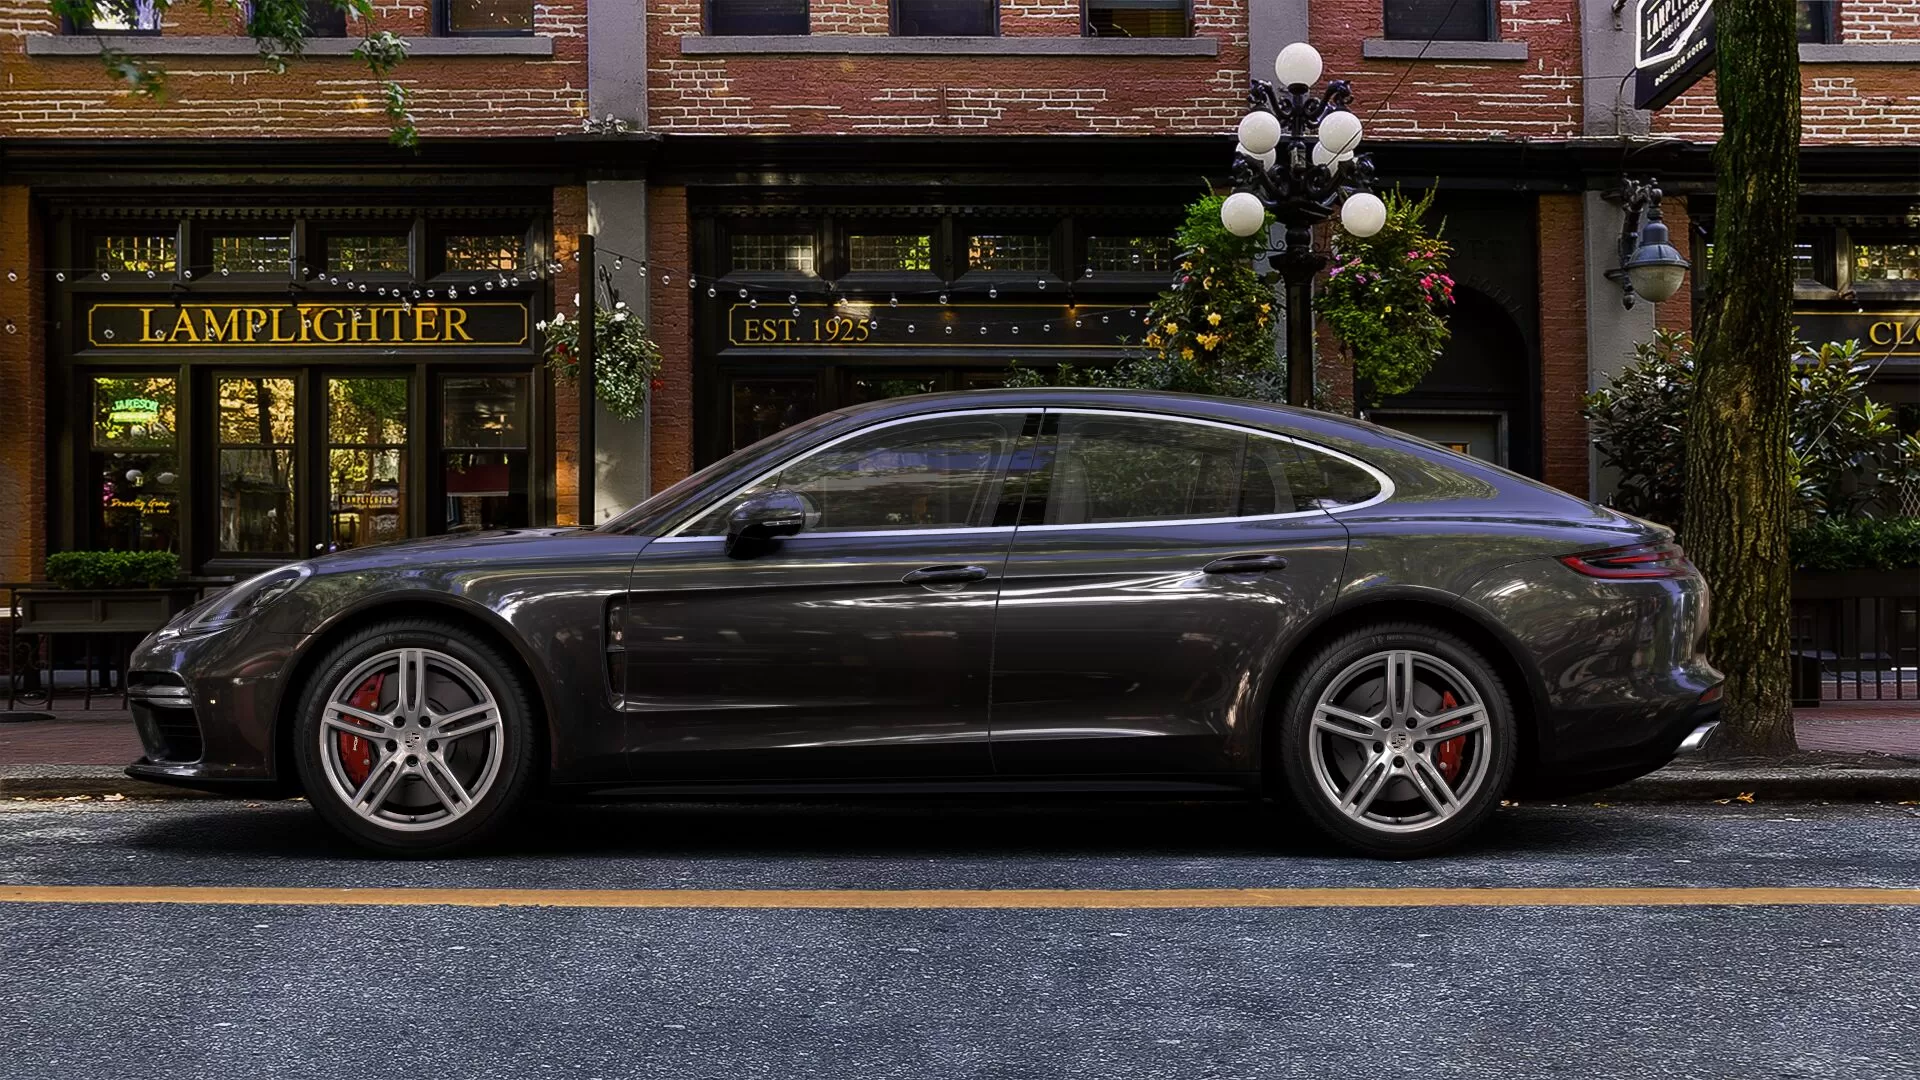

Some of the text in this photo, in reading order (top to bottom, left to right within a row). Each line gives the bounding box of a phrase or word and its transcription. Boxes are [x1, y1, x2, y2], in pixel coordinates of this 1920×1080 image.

[1687, 37, 1708, 60] HOTEL
[139, 308, 474, 342] LAMPLIGHTER
[743, 318, 869, 341] EST. 1925
[1869, 322, 1920, 345] CL
[112, 398, 159, 412] JAMESON
[341, 496, 393, 504] LAMPLIGHTER
